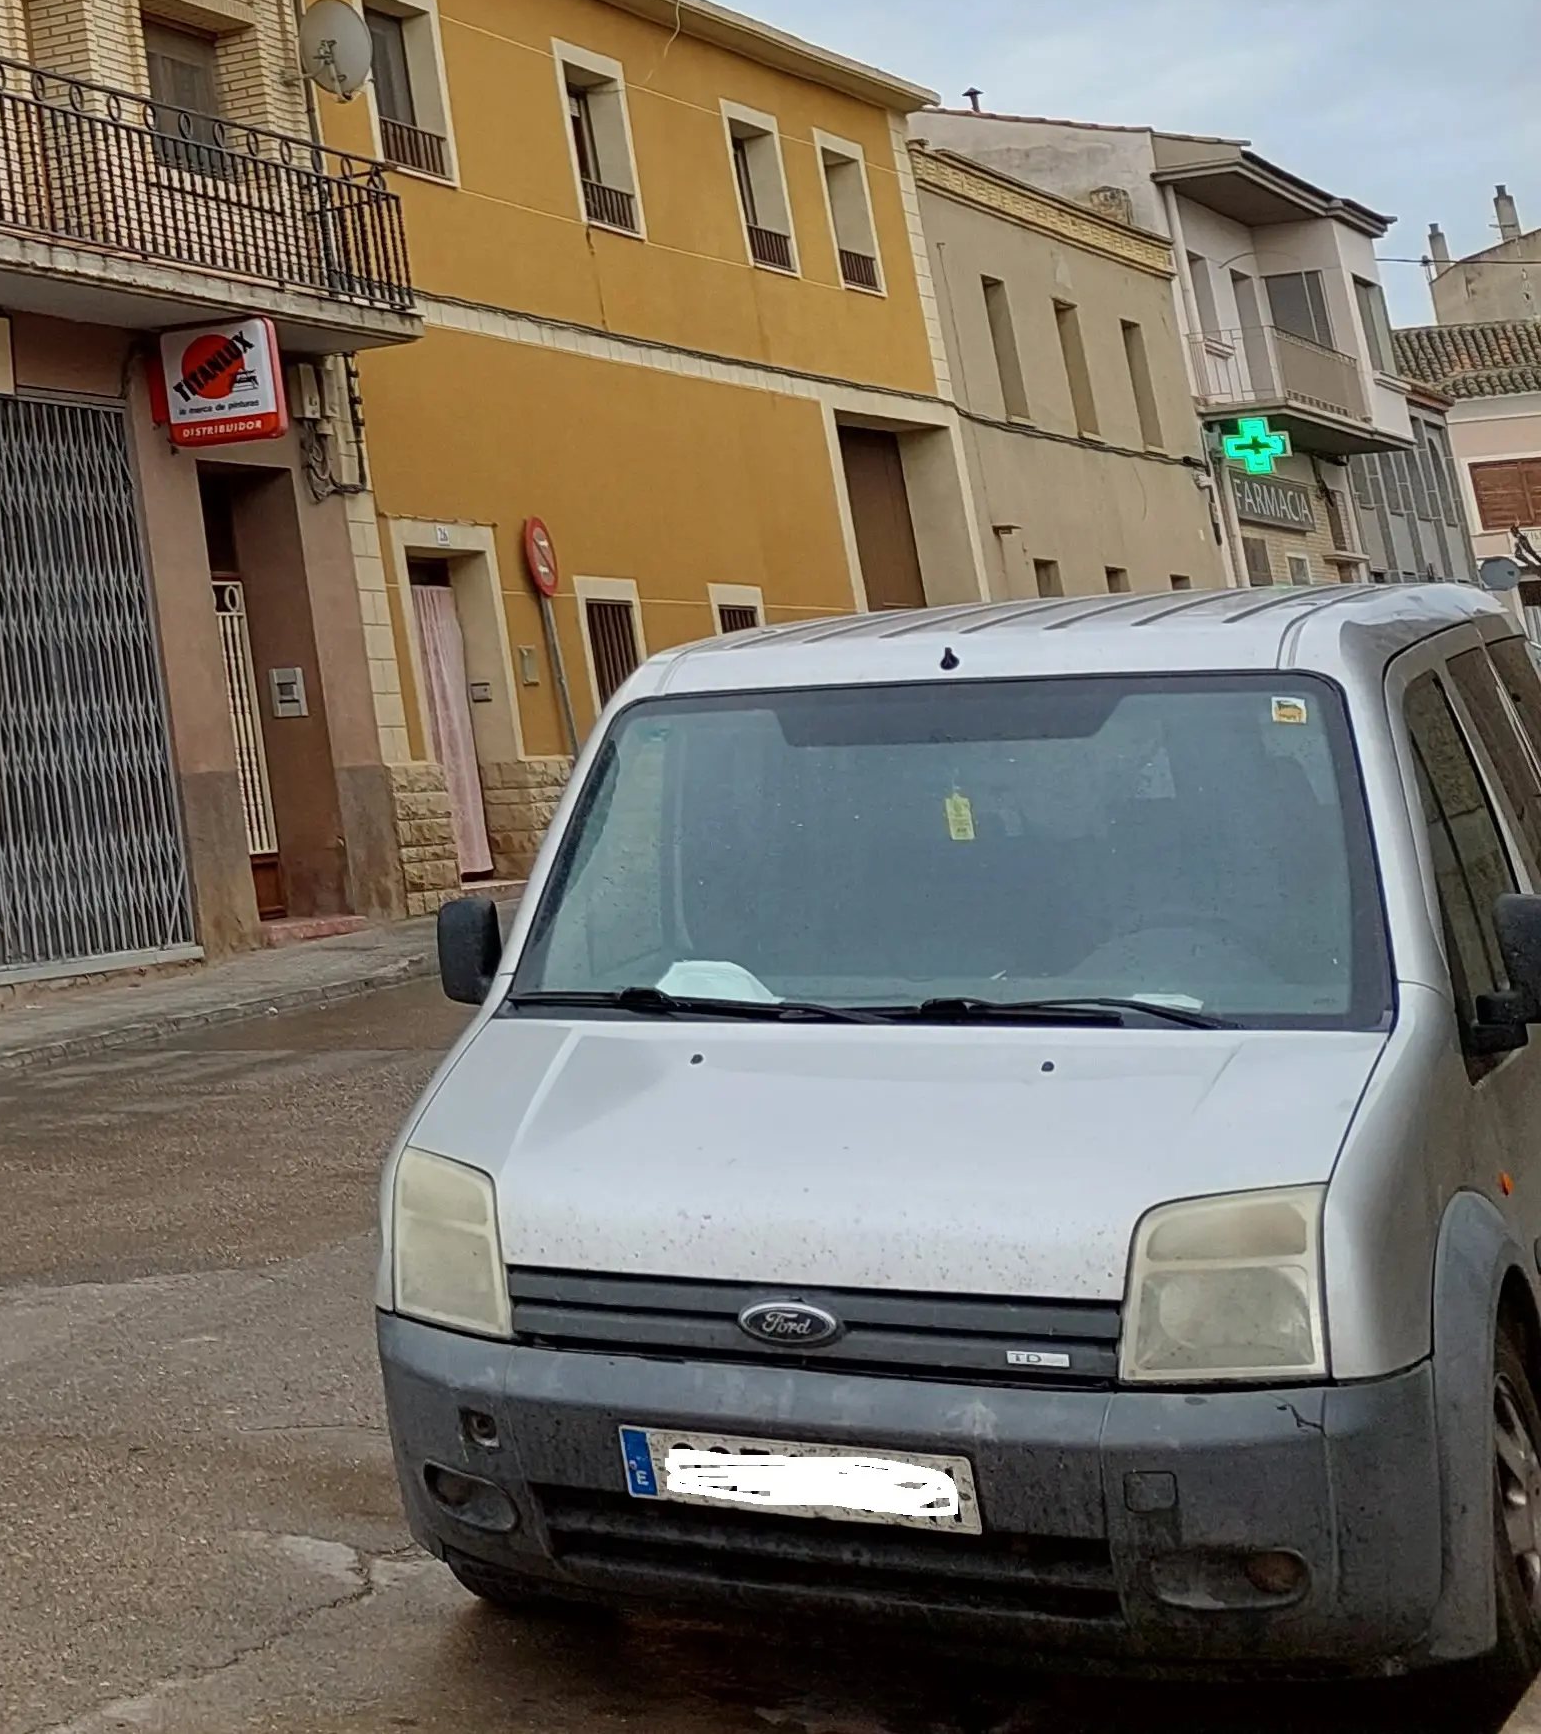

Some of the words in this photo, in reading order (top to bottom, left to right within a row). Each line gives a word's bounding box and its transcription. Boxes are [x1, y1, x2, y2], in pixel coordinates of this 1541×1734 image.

[172, 330, 255, 402] TITANLUX
[182, 419, 263, 438] DISTRIBUIDOR
[1233, 478, 1314, 524] FARMACIA
[761, 1311, 812, 1335] Ford
